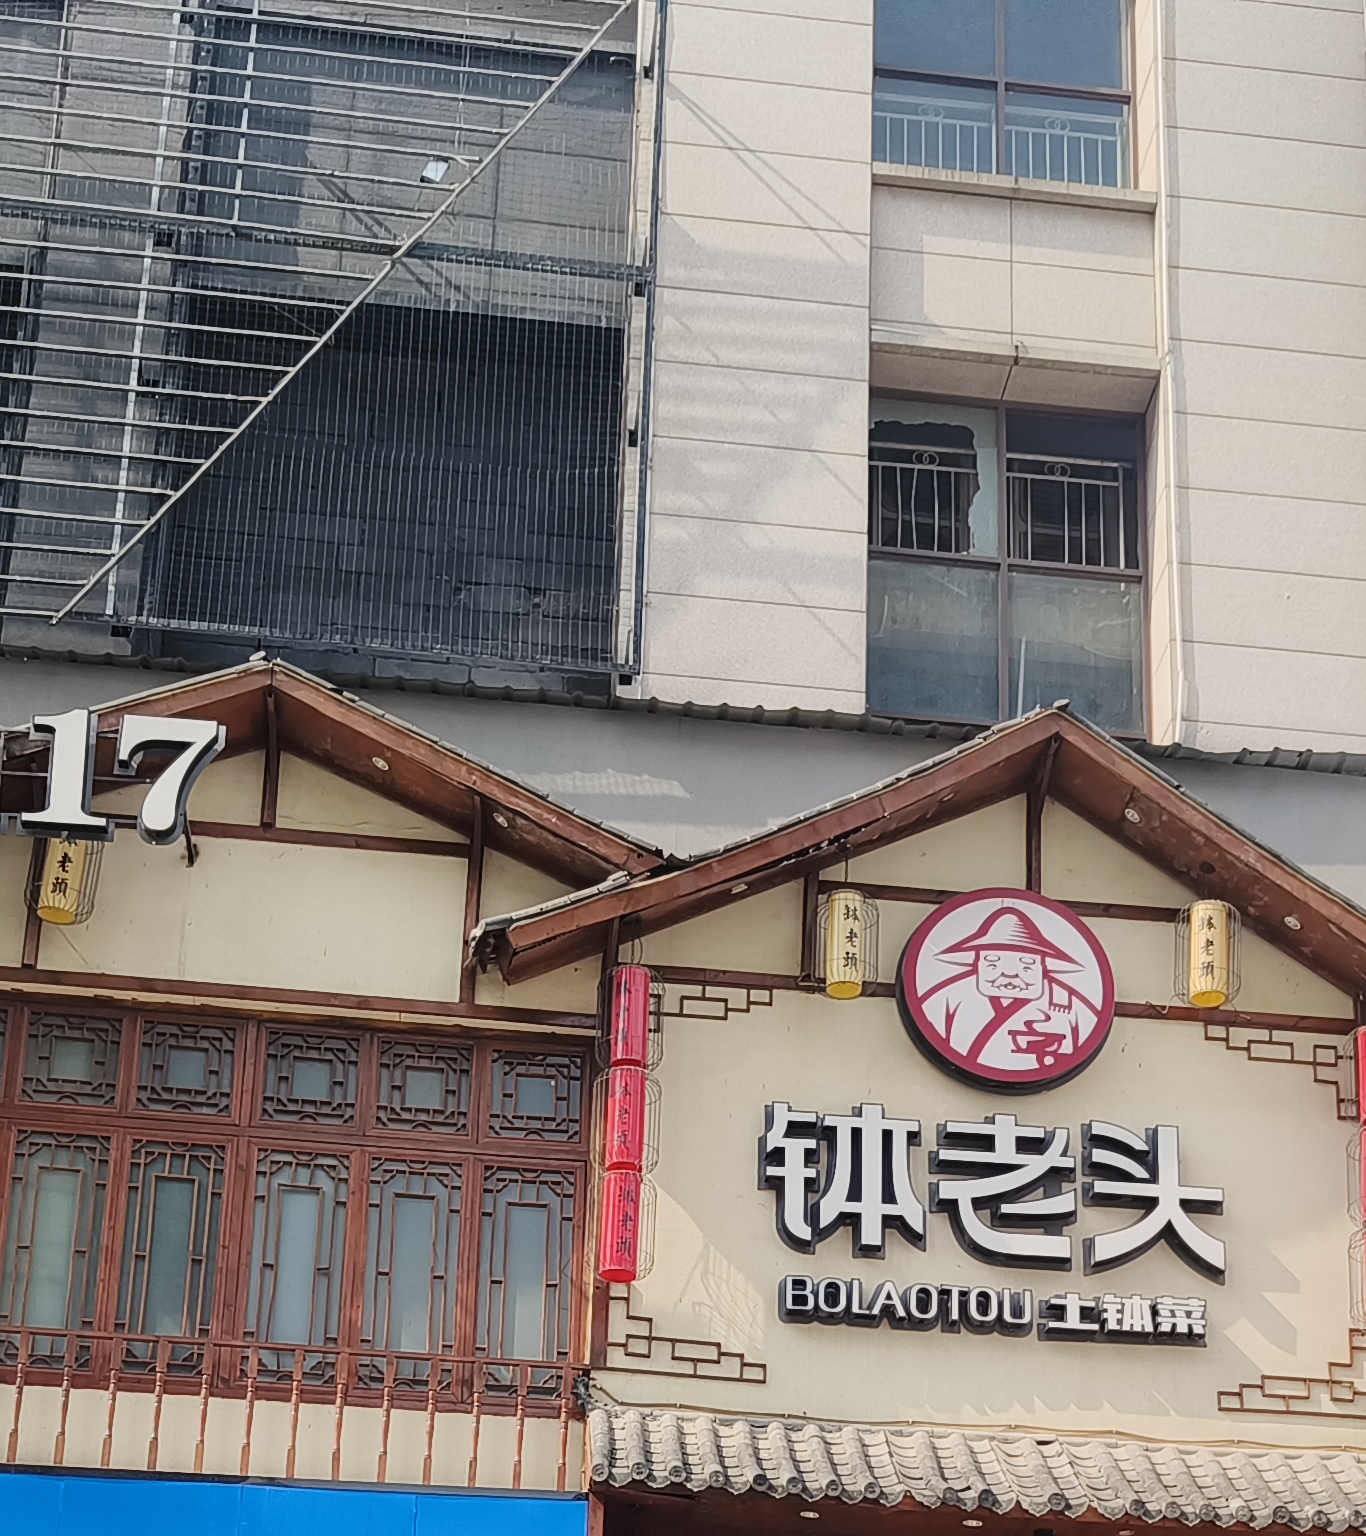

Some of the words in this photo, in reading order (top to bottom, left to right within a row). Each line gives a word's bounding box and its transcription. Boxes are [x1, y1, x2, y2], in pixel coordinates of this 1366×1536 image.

[765, 1101, 1227, 1282] 钵老头
[782, 1274, 1035, 1332] BOLAOTOU
[1045, 1293, 1211, 1343] 土钵菜
